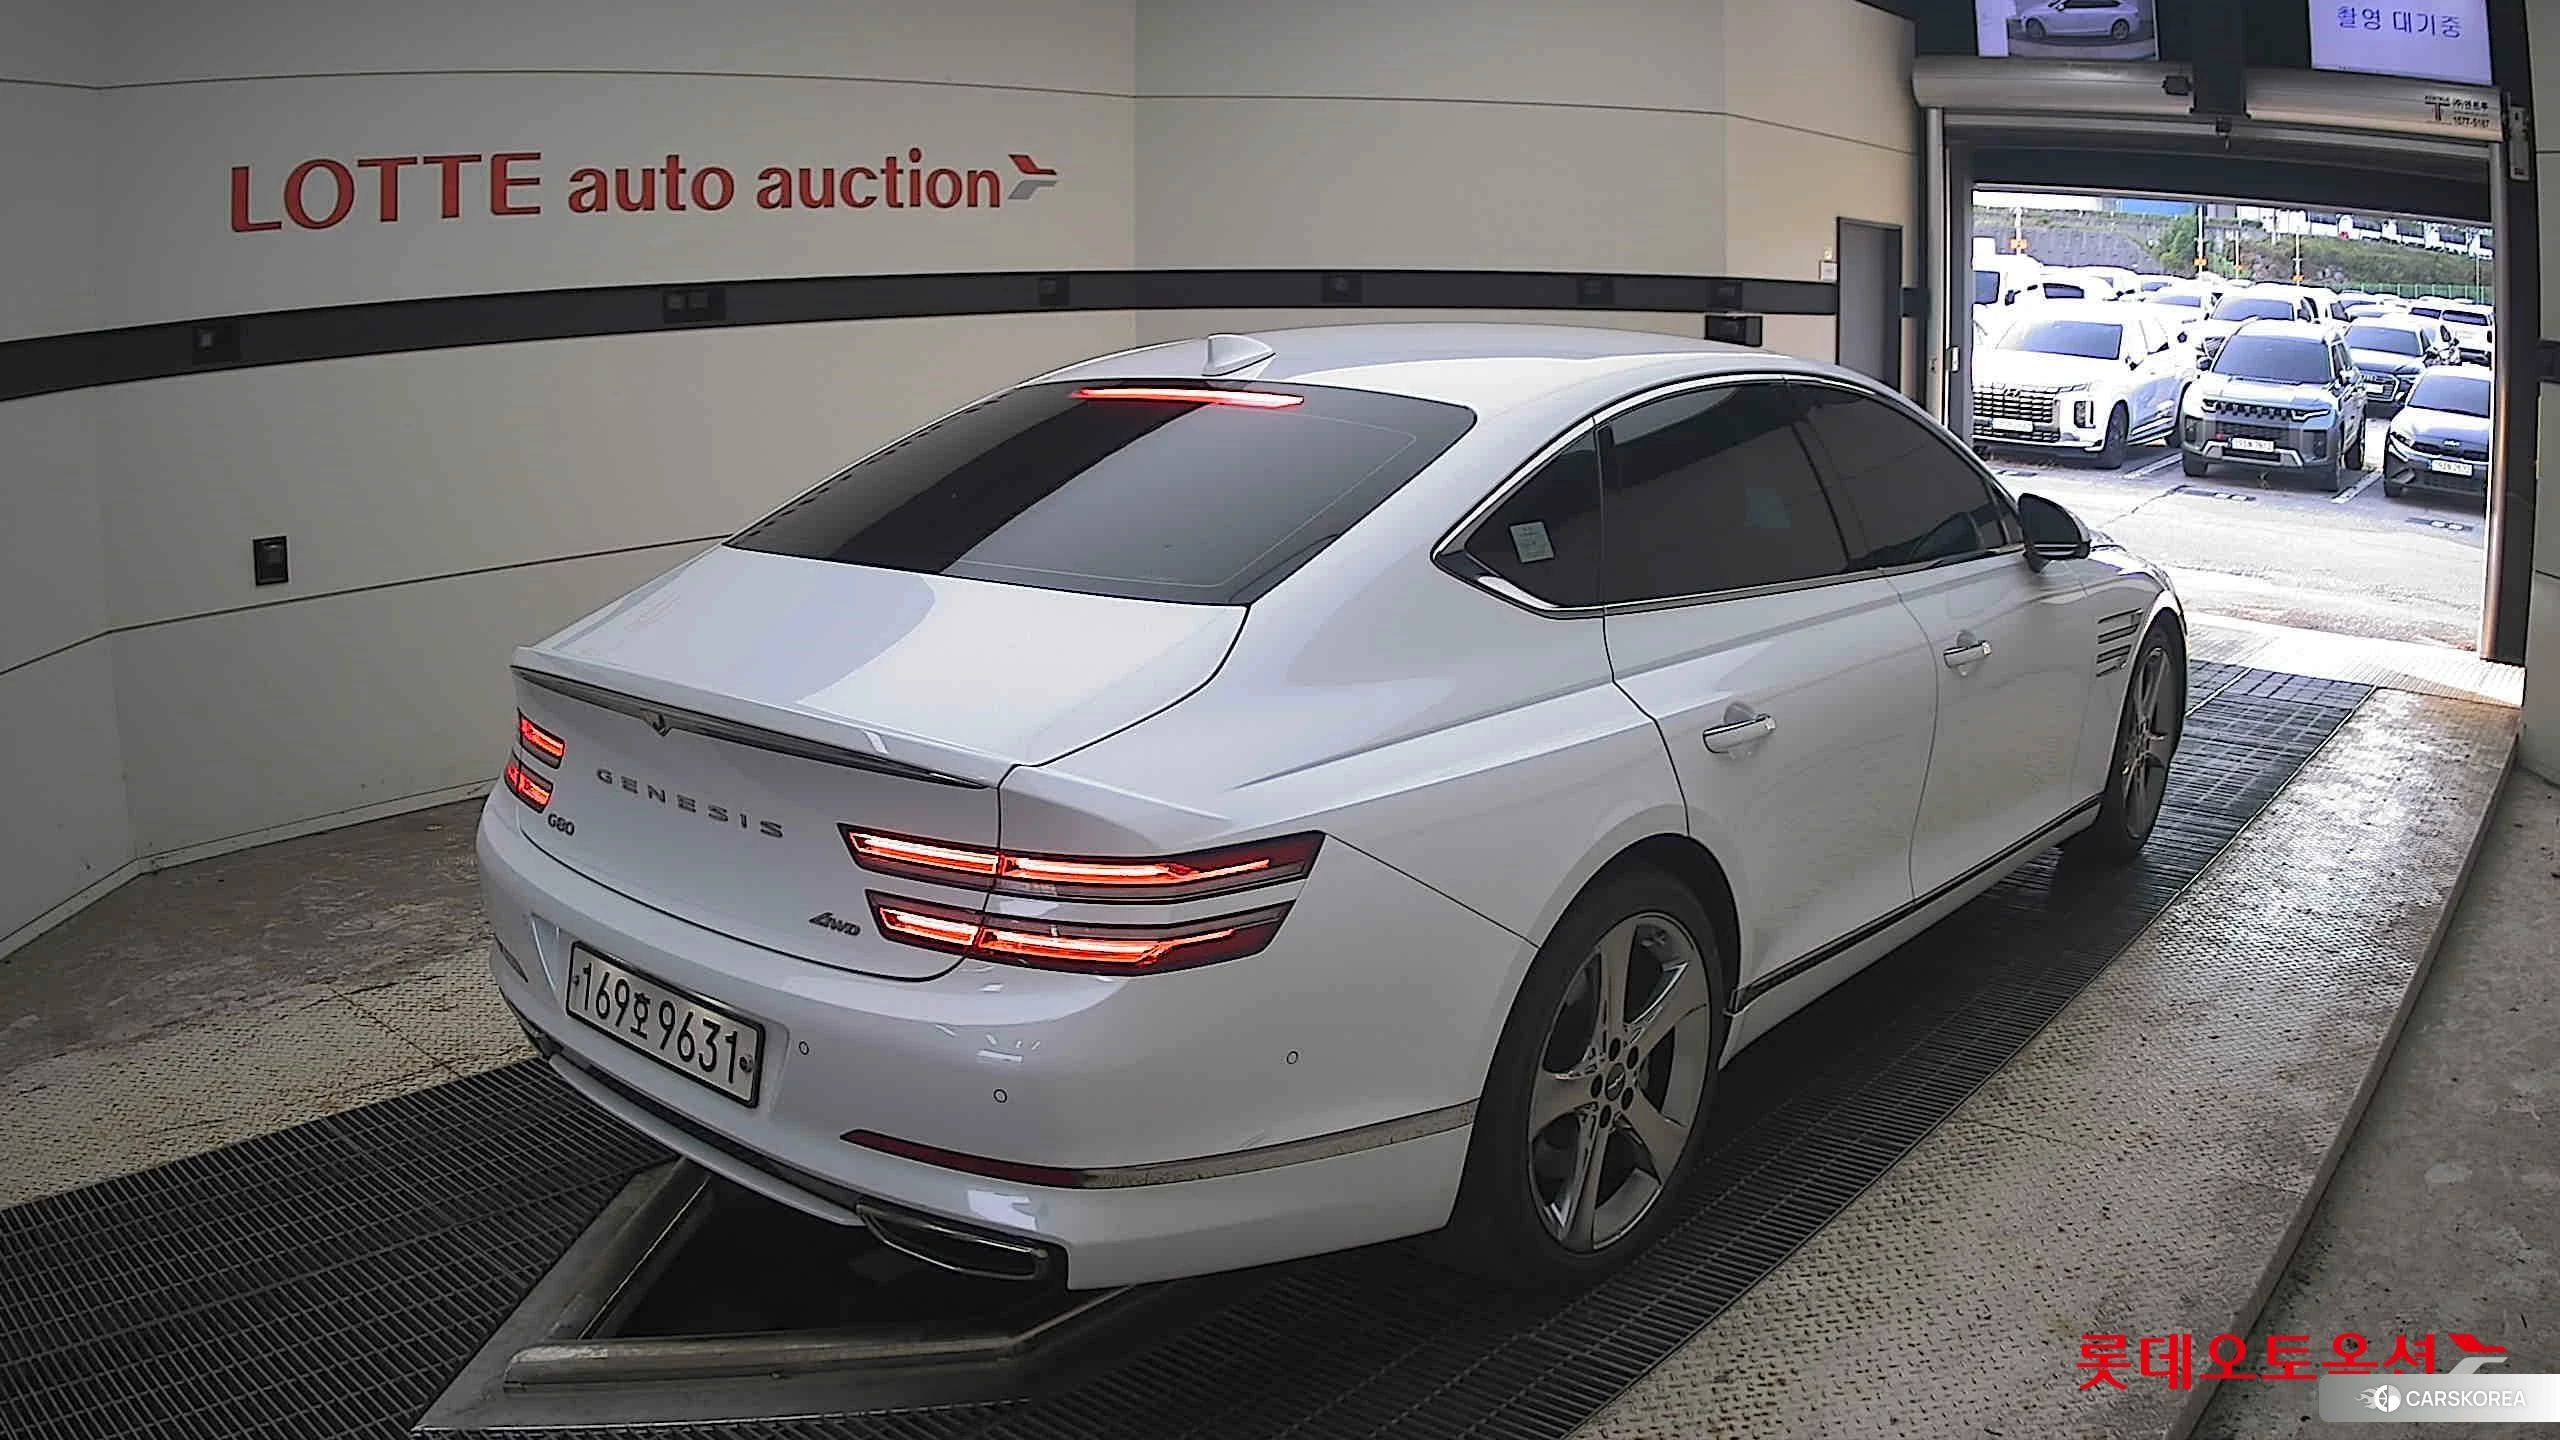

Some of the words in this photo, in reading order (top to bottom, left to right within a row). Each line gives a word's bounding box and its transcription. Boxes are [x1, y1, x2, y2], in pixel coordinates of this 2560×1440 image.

[2392, 11, 2462, 39] 대기중
[231, 152, 541, 233] LOTTE
[568, 154, 736, 214] auto
[756, 147, 1001, 211] auction
[596, 768, 784, 839] GENESIS
[547, 812, 575, 837] G80
[809, 911, 861, 937] AWD
